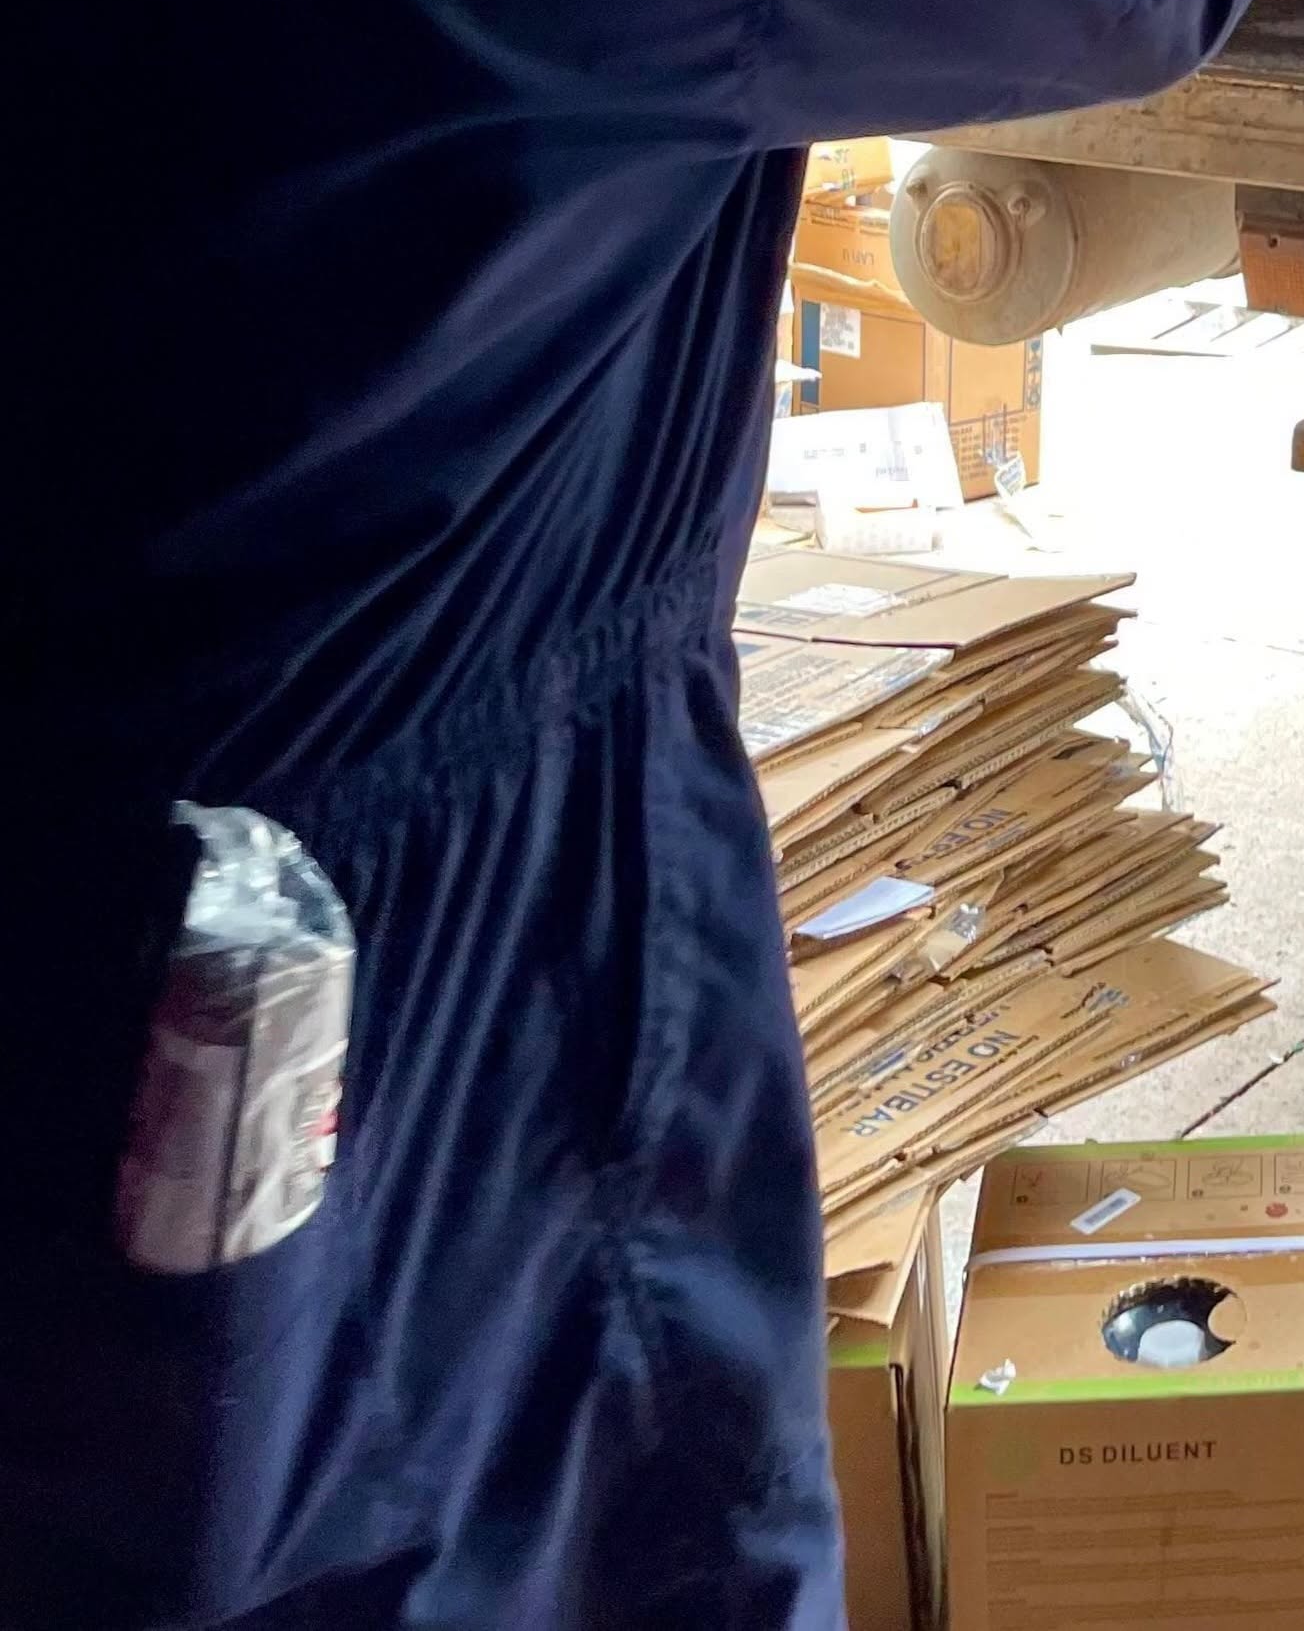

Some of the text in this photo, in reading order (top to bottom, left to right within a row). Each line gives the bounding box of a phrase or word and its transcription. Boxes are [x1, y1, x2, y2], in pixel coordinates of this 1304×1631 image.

[967, 1028, 1021, 1058] NO
[845, 1059, 977, 1138] ESTIBAR
[1059, 1440, 1218, 1467] DS DILUENT
